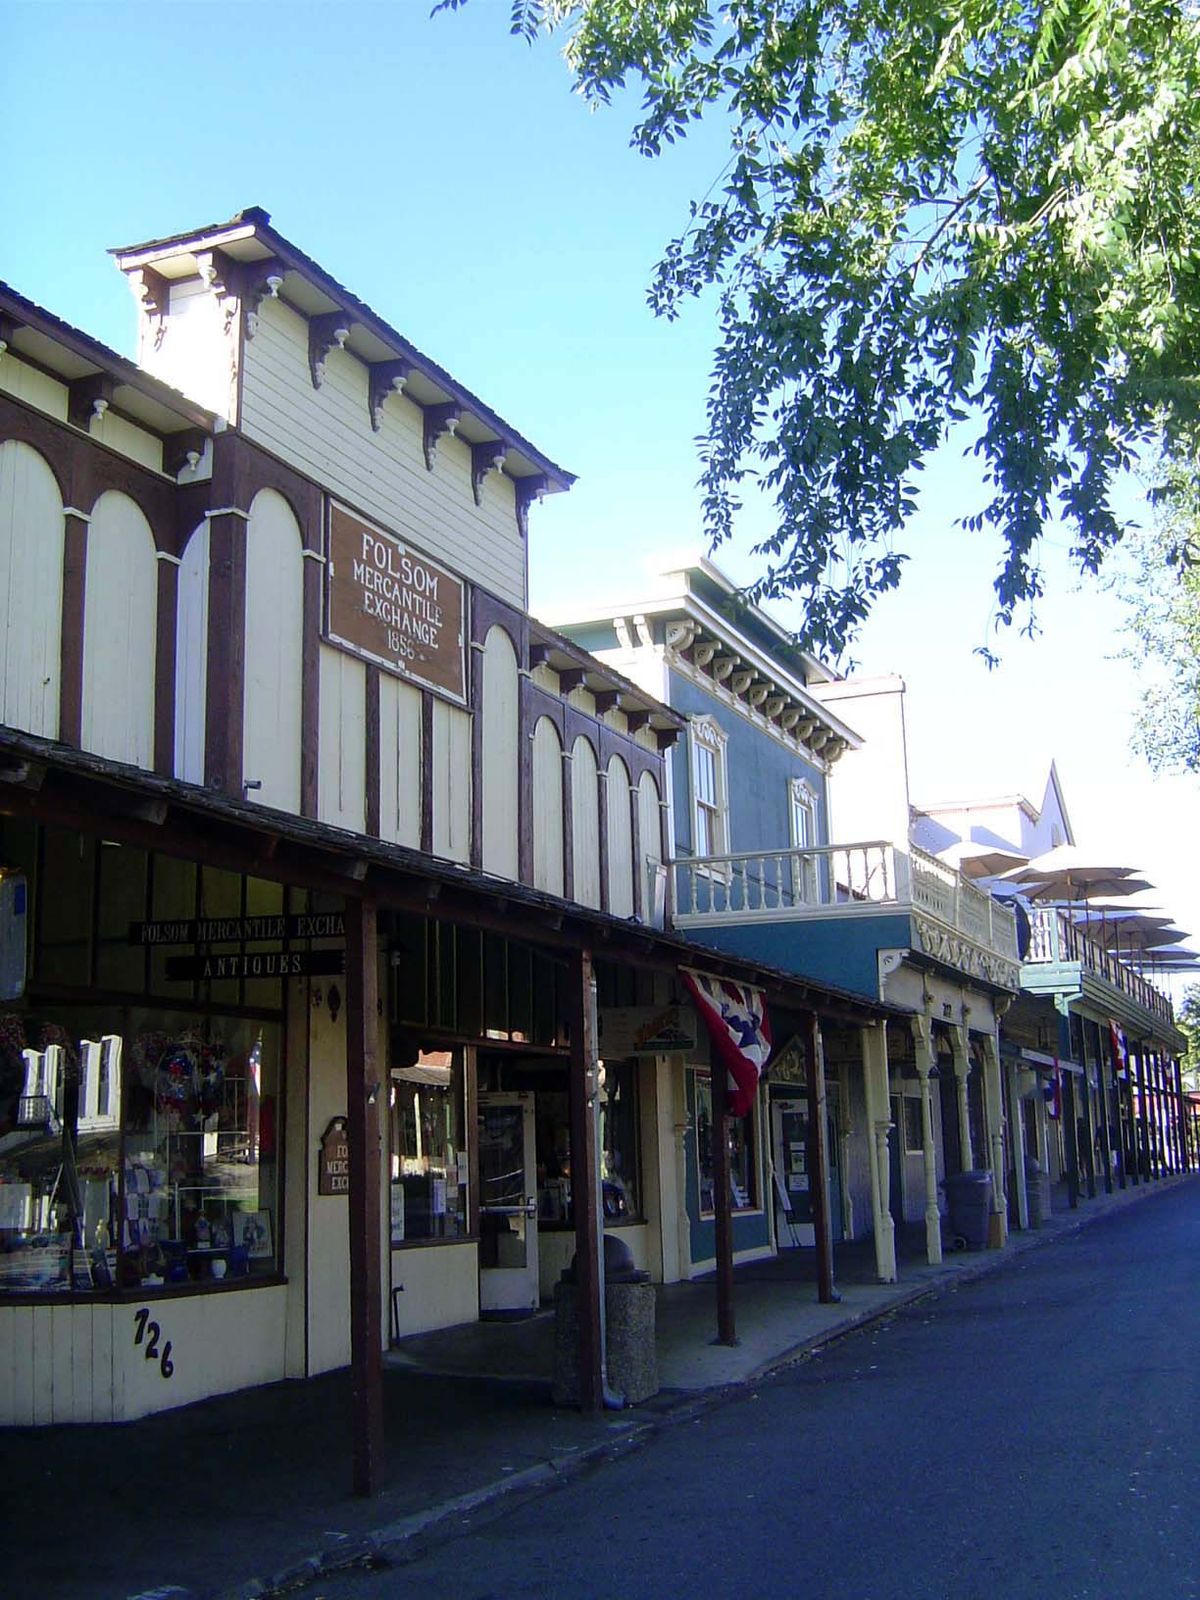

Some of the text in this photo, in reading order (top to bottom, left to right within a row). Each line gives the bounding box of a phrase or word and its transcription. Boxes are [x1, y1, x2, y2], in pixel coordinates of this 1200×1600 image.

[353, 558, 443, 628] MERCANTILE
[361, 532, 439, 601] FOLSOM
[363, 591, 440, 649] EXCHANGE
[140, 923, 189, 943] FOLSOM
[197, 918, 285, 942] MERCANTILE
[203, 953, 302, 977] ANTIQUES
[134, 1308, 174, 1378] 726
